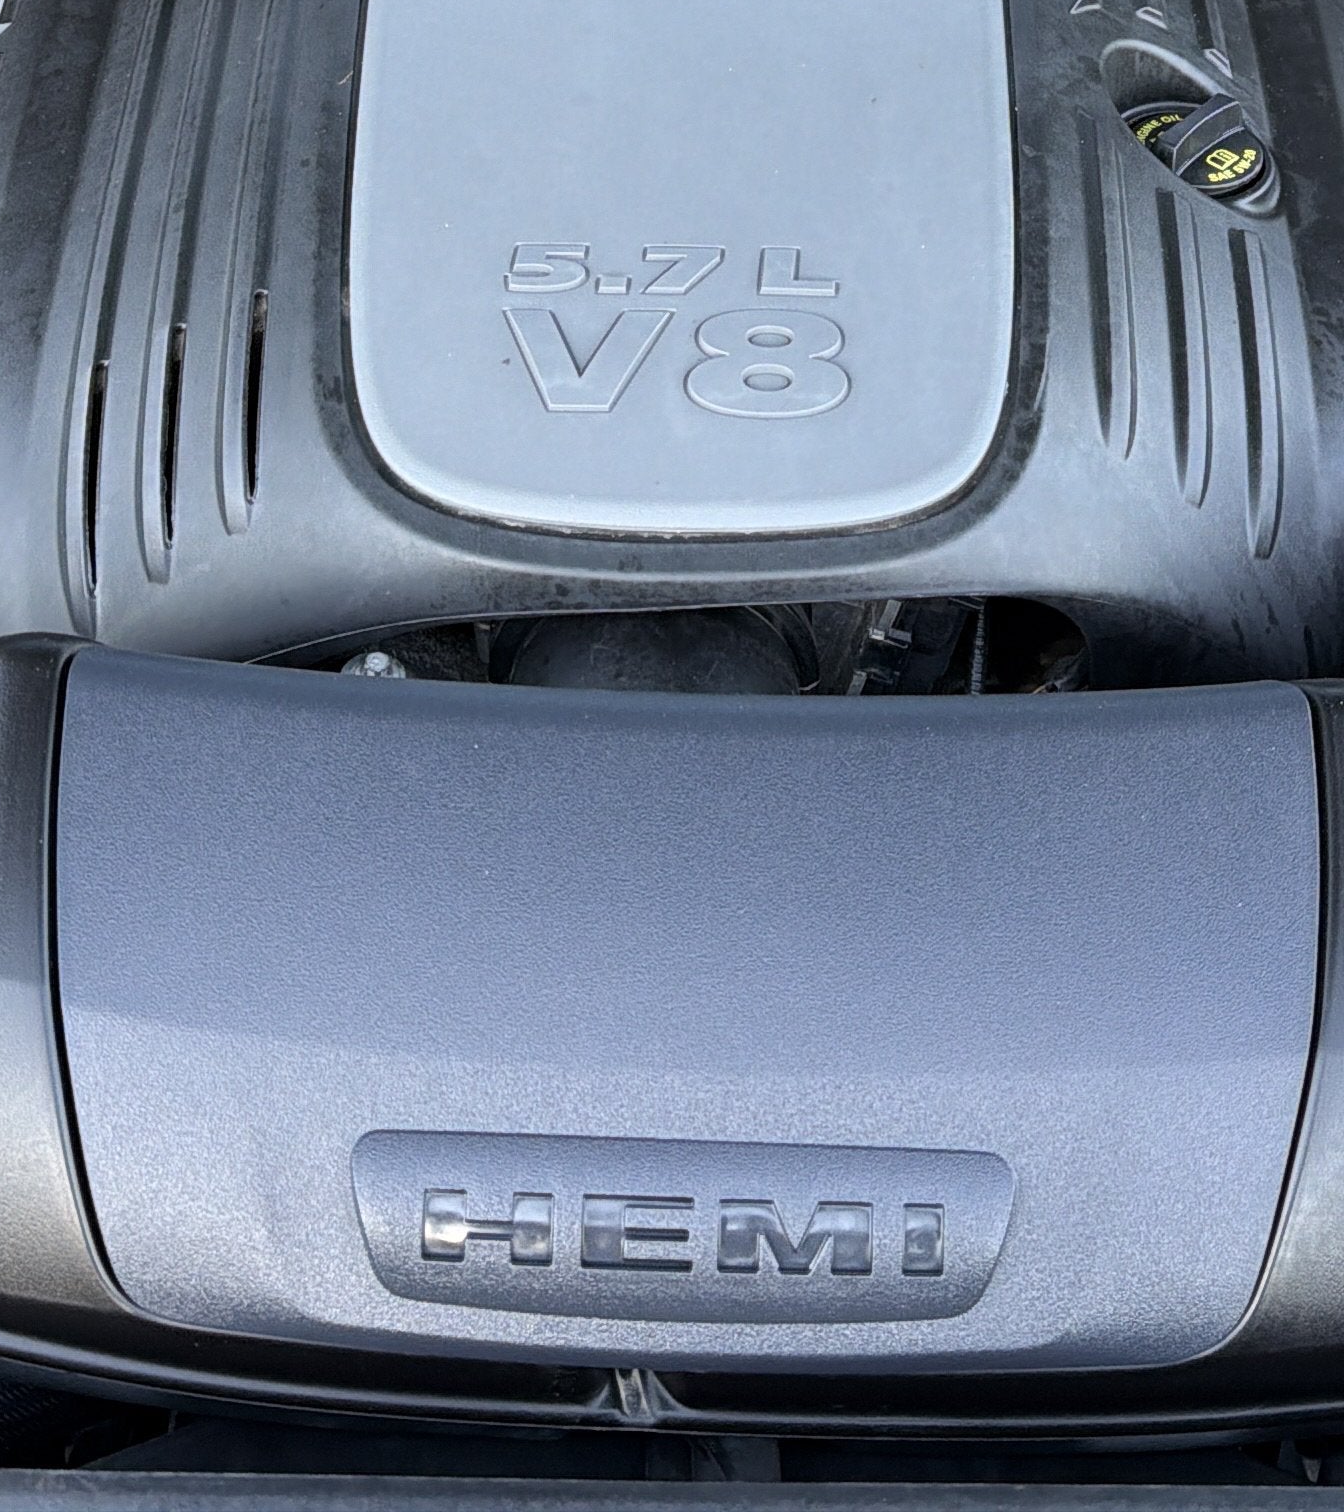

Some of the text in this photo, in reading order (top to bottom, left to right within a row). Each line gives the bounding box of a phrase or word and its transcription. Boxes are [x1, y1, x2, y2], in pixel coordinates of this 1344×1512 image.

[1137, 119, 1162, 145] NGINE
[1208, 149, 1257, 182] SAE 5W-20
[502, 307, 851, 419] V8
[420, 1187, 946, 1277] HEMI
